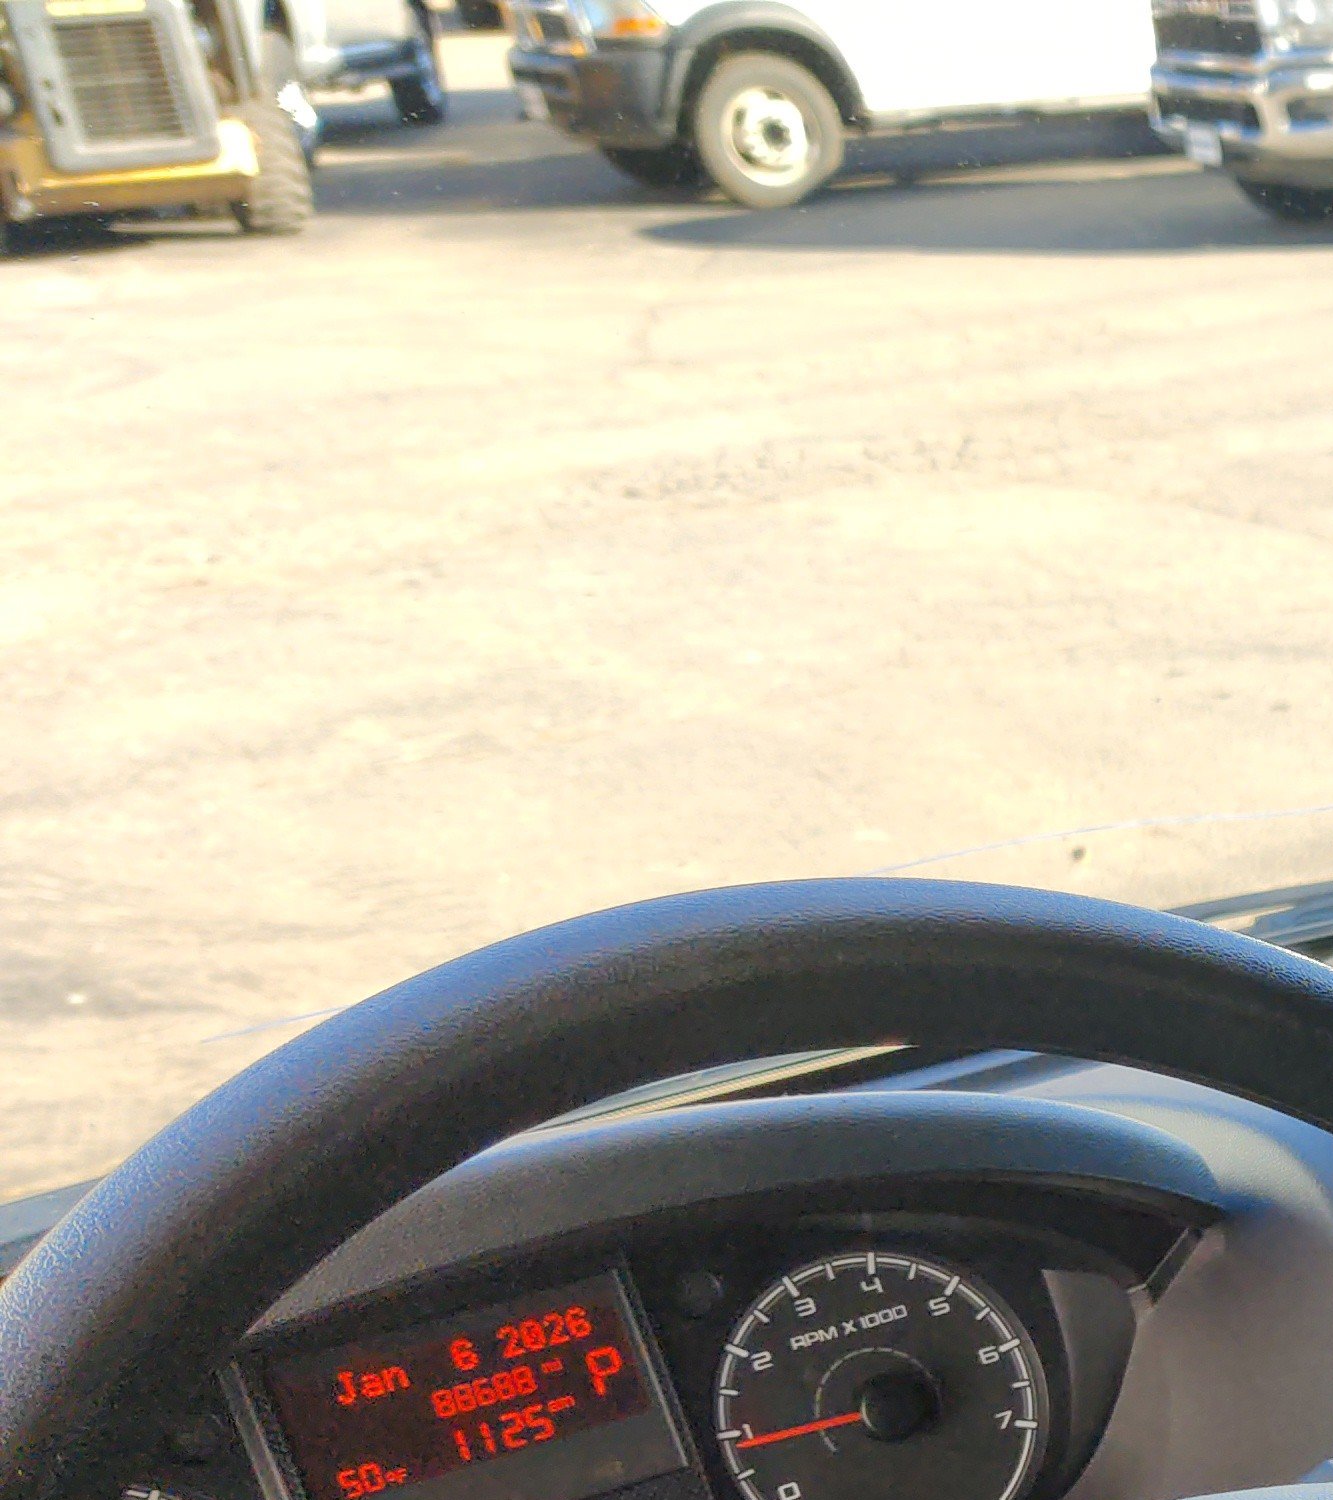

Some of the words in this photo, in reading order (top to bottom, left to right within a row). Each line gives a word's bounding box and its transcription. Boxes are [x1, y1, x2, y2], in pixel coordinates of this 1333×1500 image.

[860, 1277, 884, 1294] 4
[793, 1297, 816, 1317] 3
[928, 1296, 950, 1317] 5
[790, 1327, 838, 1350] RPM
[859, 1303, 908, 1330] 1000
[338, 1366, 410, 1406] Jan
[451, 1338, 479, 1371] 6
[497, 1305, 592, 1358] 2026
[750, 1351, 773, 1371] 2
[977, 1345, 1000, 1365] 6
[585, 1346, 622, 1396] P
[993, 1409, 1013, 1430] 7
